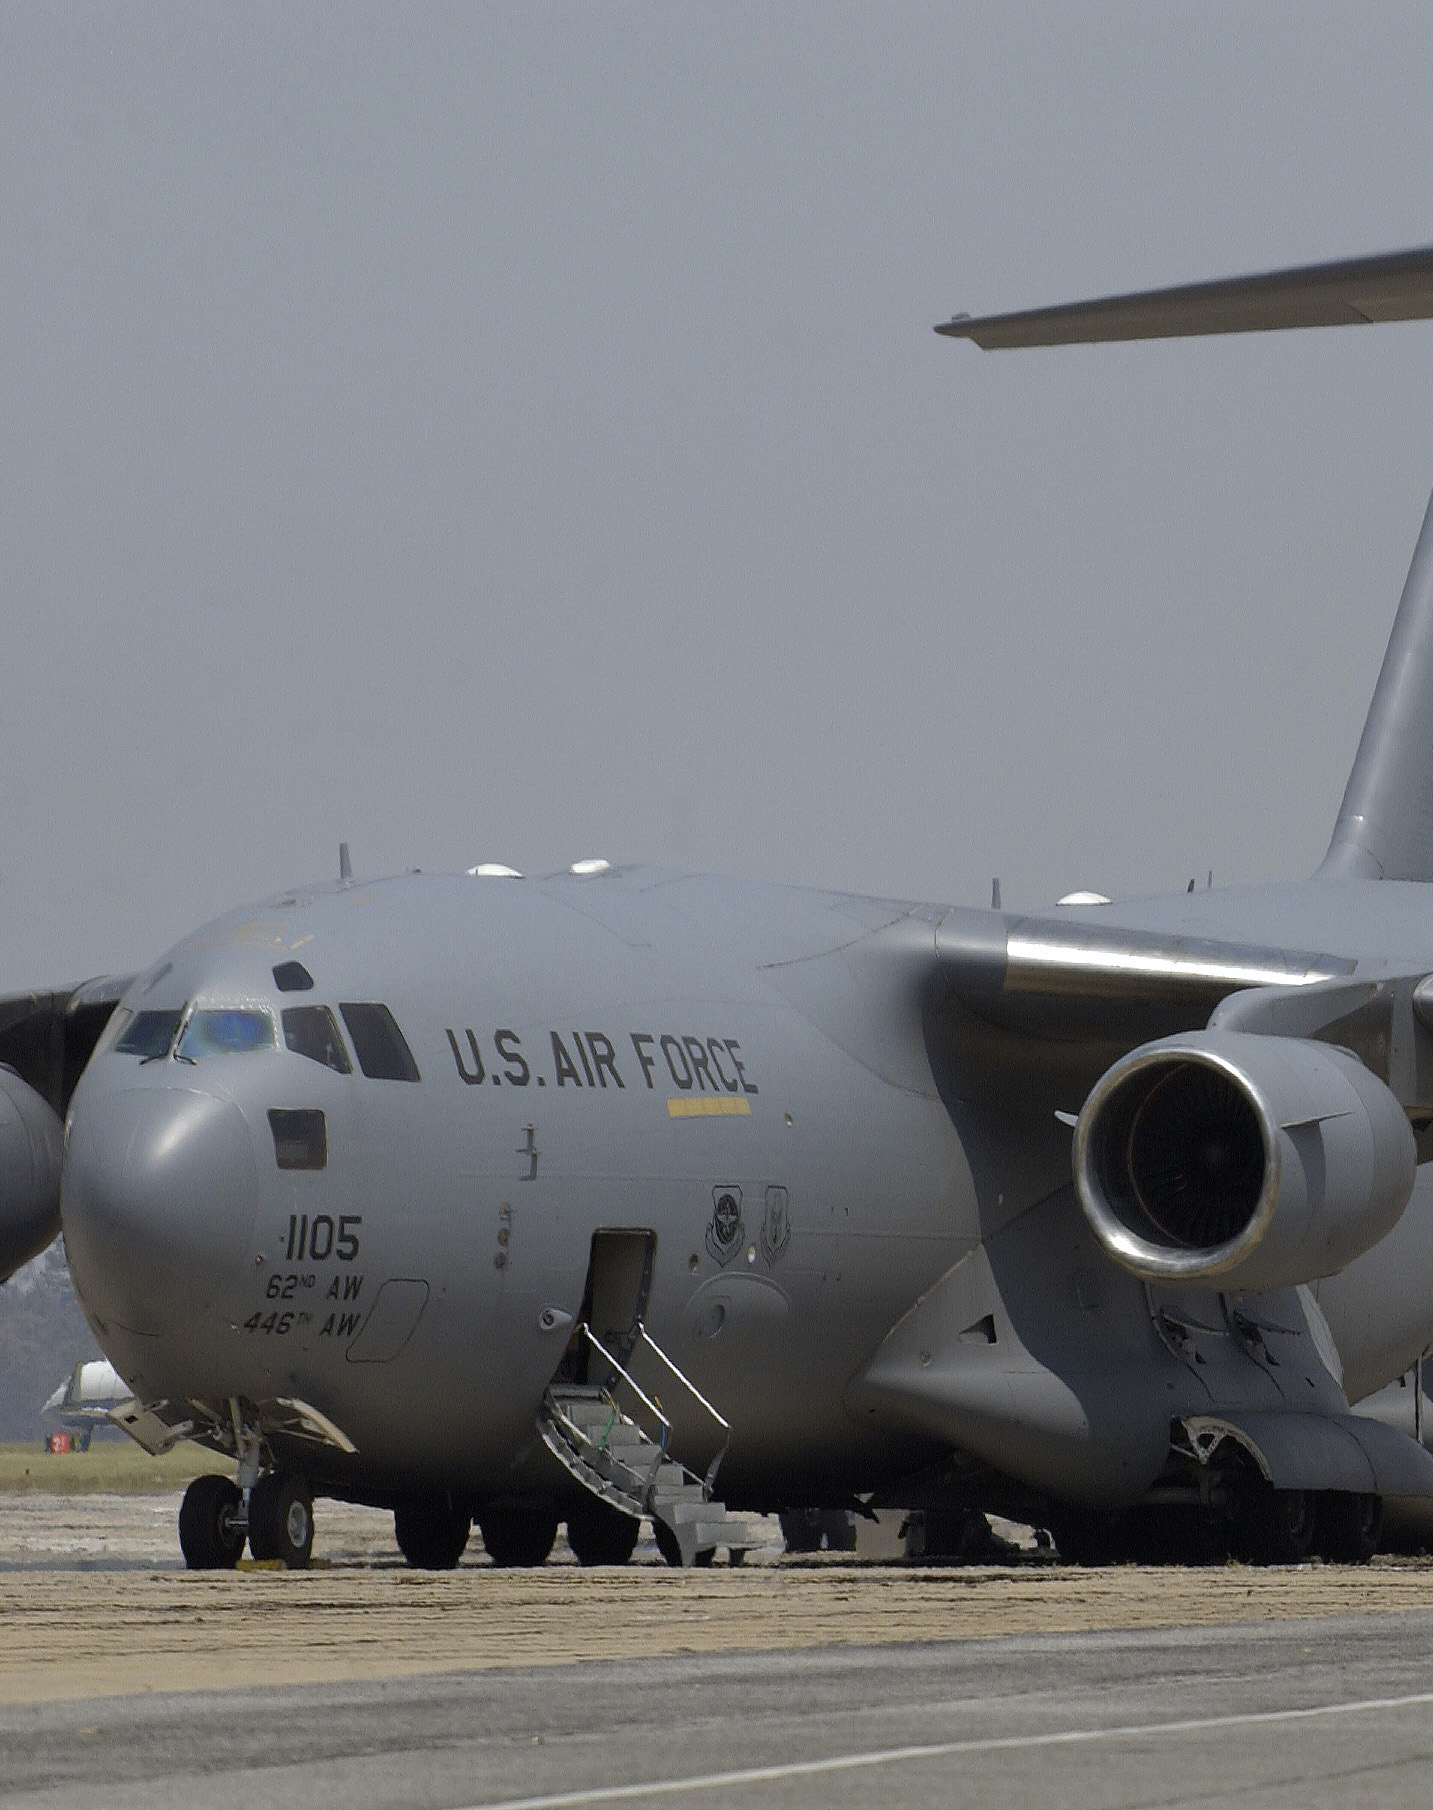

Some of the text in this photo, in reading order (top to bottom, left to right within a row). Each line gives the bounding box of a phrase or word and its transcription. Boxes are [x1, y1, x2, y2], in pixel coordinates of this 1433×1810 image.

[445, 1028, 759, 1094] U.S. AIR FORCE
[286, 1213, 362, 1260] 1105
[326, 1274, 364, 1300] AW
[319, 1313, 361, 1337] AW
